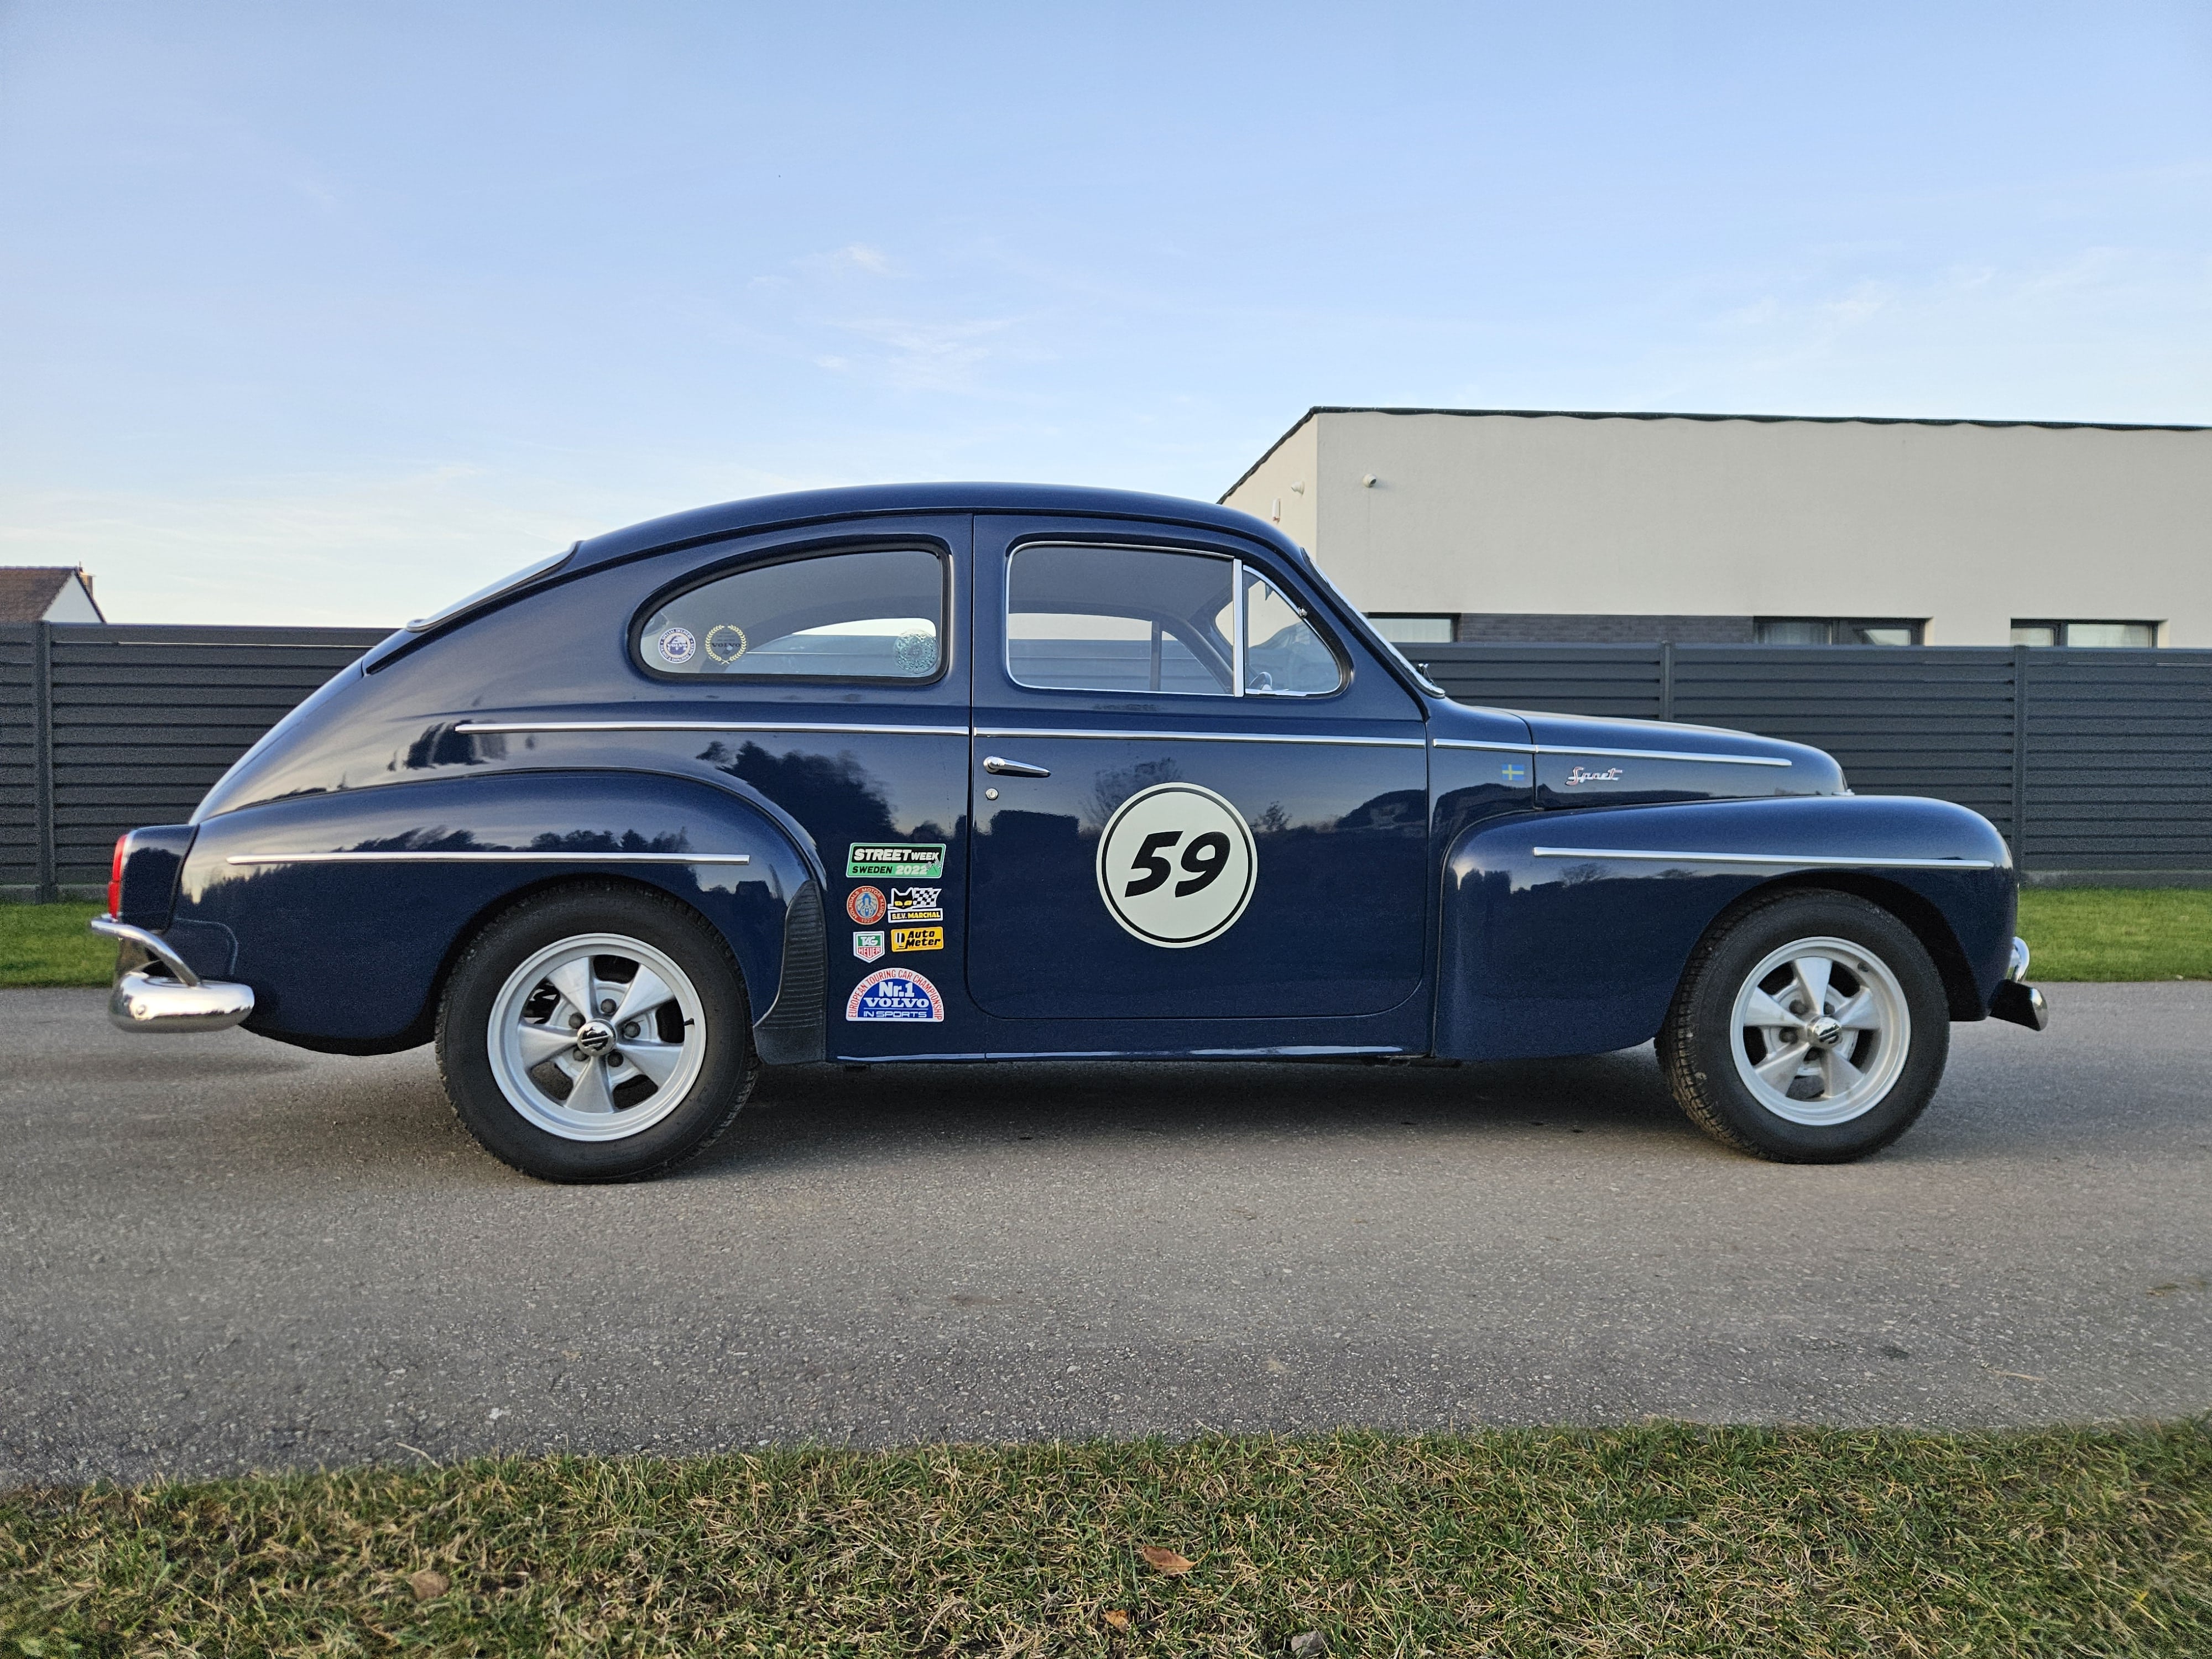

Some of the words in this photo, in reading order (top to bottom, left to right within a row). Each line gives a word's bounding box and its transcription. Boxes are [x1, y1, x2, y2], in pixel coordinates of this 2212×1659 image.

[1565, 766, 1623, 785] Sport
[895, 864, 928, 875] 2022
[1124, 831, 1231, 898] 59
[862, 888, 881, 897] MOTOR
[907, 930, 935, 938] Auto
[860, 936, 878, 946] TAG
[905, 938, 941, 948] Meter
[858, 947, 880, 958] HEUER
[848, 984, 867, 1017] EUROPEAN
[866, 969, 896, 985] TOURING
[898, 969, 912, 979] CAR
[913, 975, 942, 1020] CHAMPIONSHIP
[863, 997, 929, 1008] VOLVO
